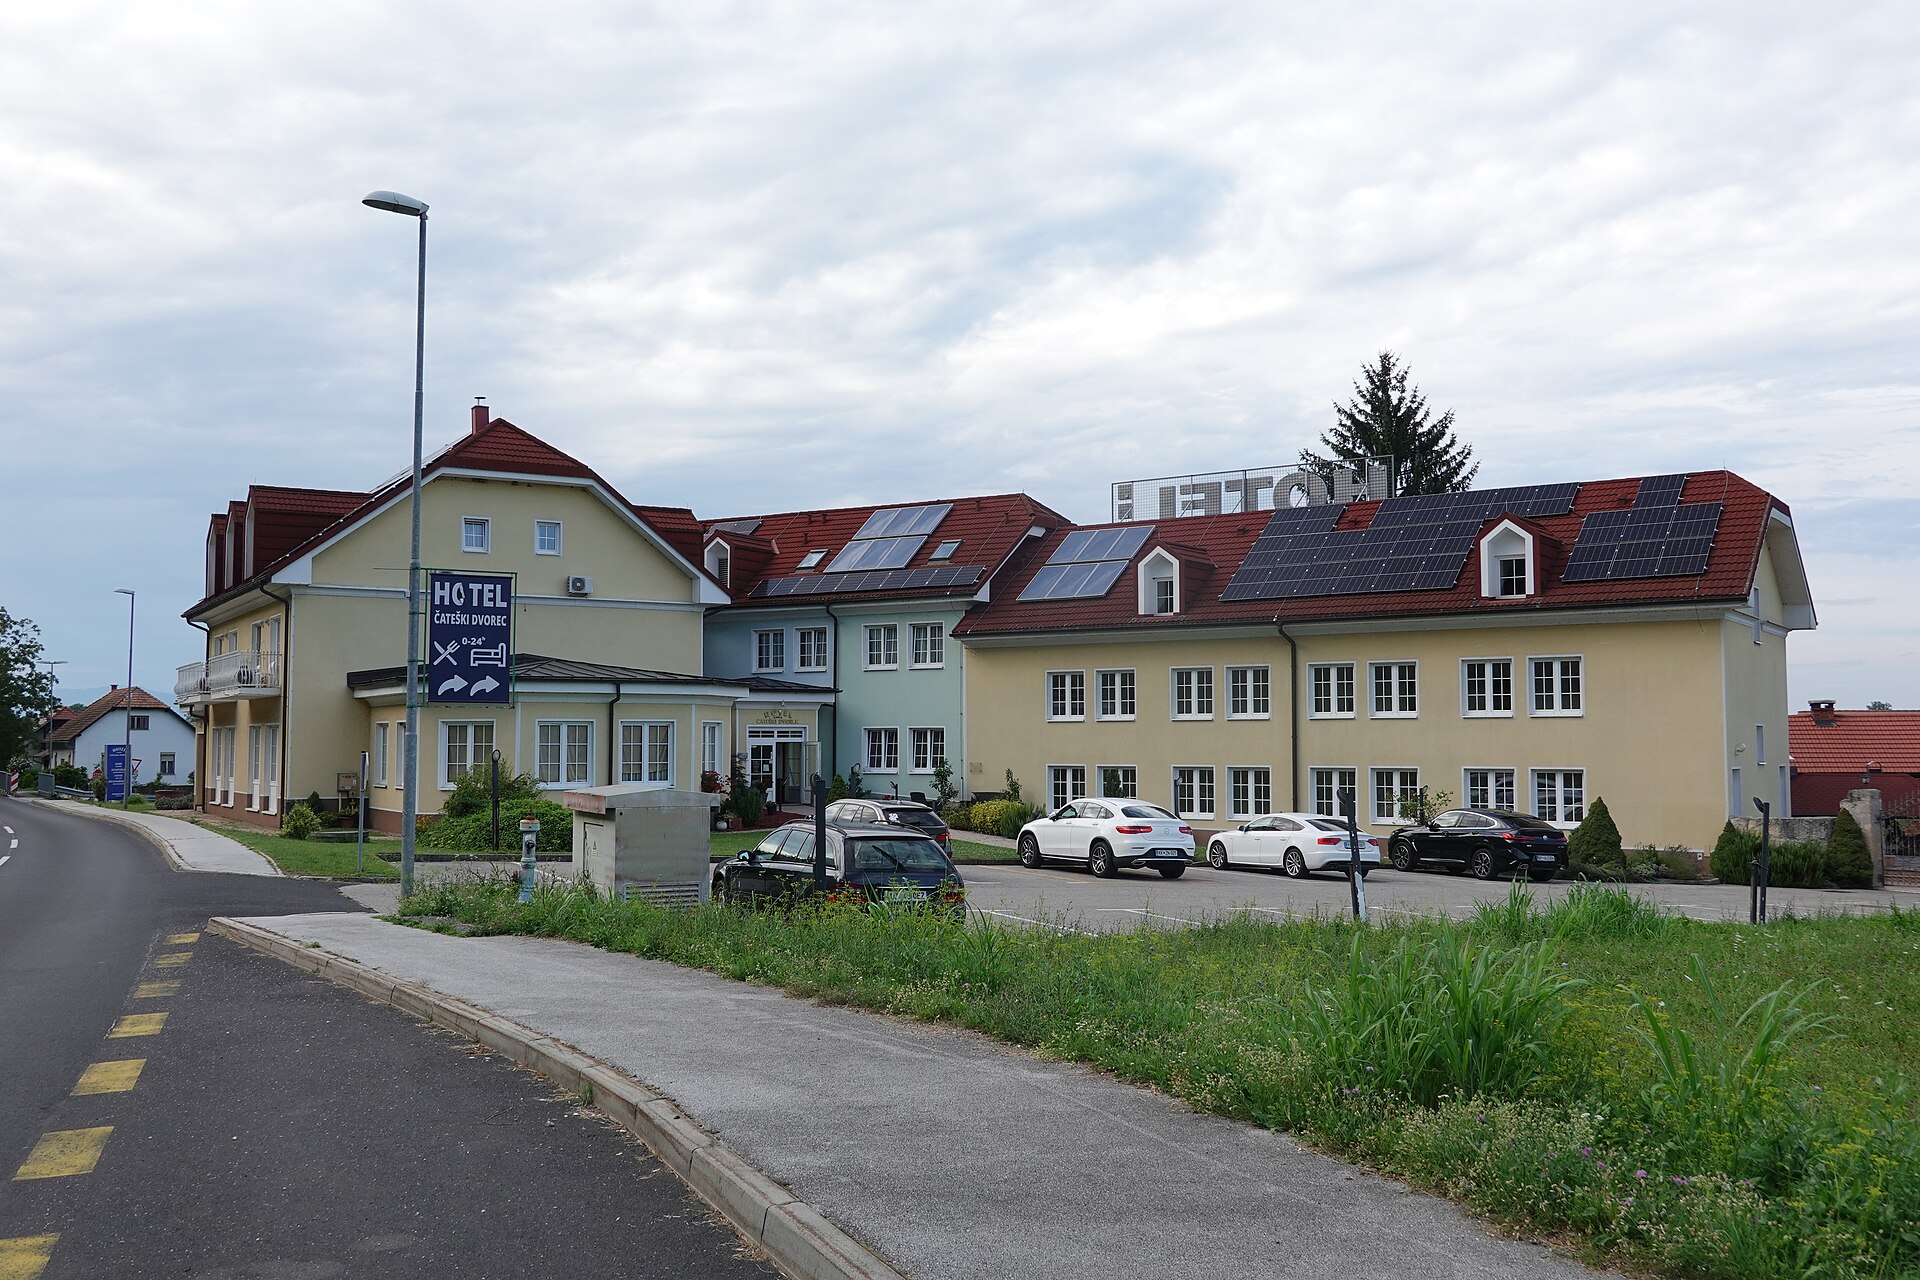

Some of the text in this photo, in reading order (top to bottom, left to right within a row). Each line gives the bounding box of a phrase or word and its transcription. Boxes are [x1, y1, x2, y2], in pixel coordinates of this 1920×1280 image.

[434, 581, 507, 607] HOTEL
[434, 610, 507, 627] ČATEŠKI DVOREC
